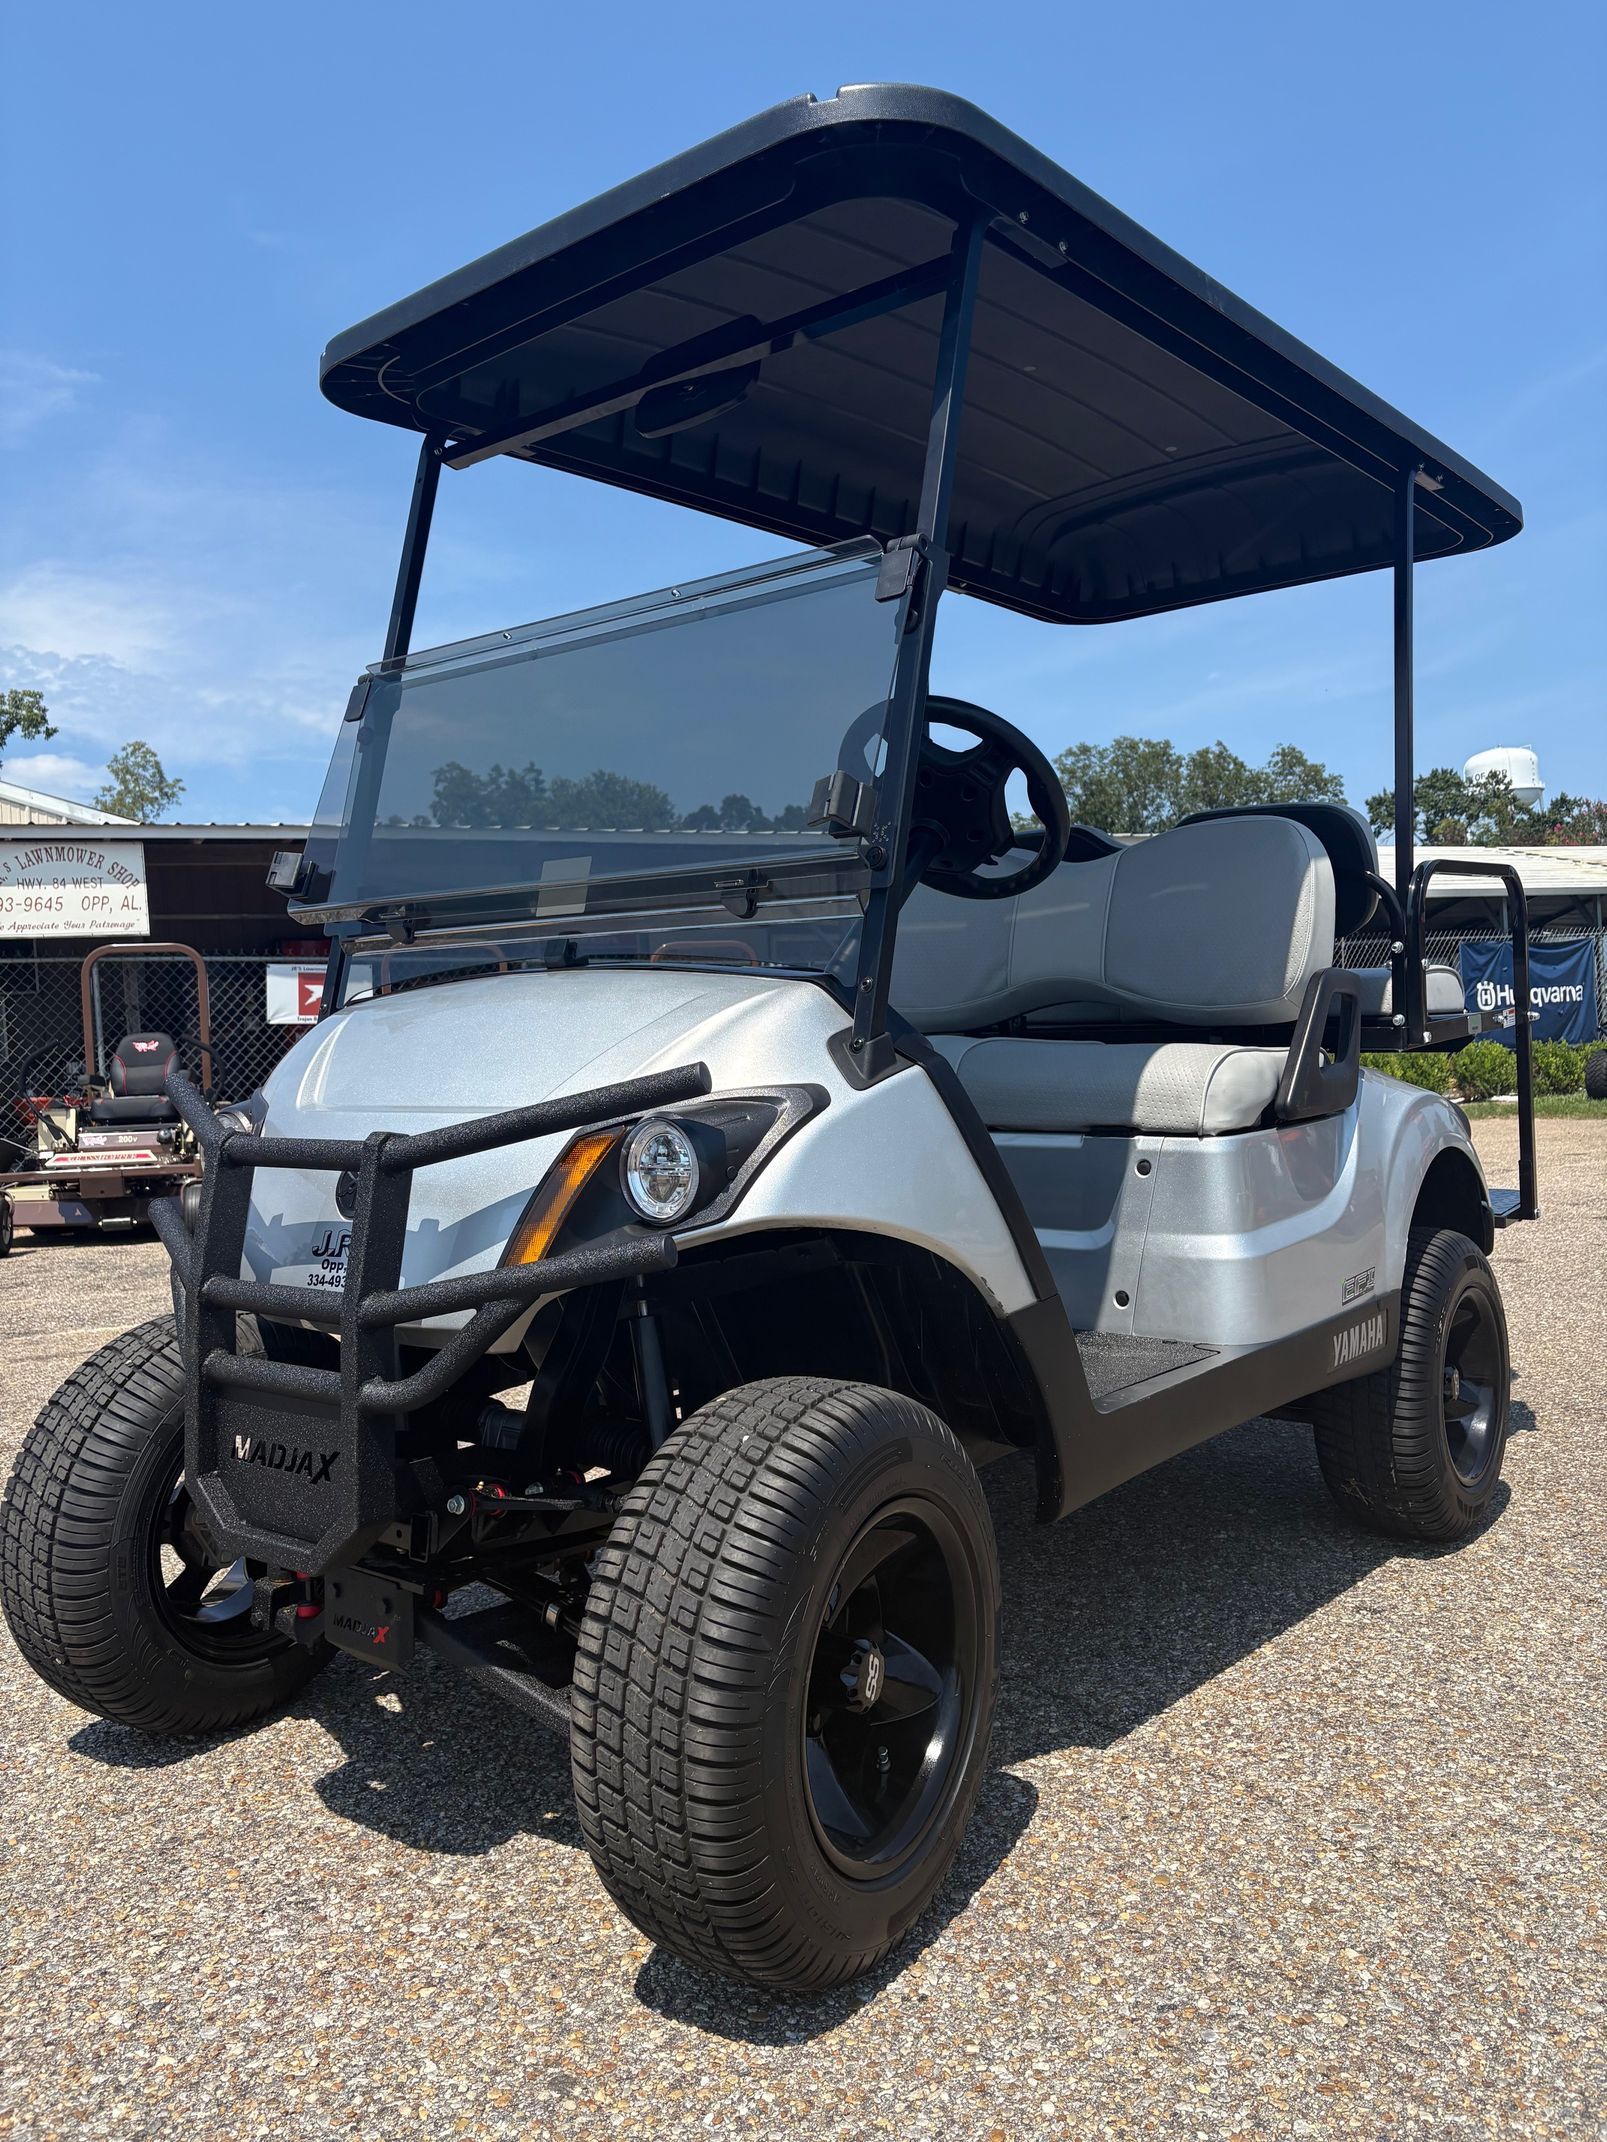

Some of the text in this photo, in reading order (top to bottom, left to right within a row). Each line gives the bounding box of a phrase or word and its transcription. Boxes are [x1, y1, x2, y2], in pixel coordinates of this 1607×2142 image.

[14, 846, 105, 870] LAWNMOWER
[107, 861, 141, 889] SHOP
[16, 877, 104, 890] HWY. 84 WEST
[81, 896, 113, 914] OPP,
[121, 896, 142, 911] AL.
[8, 921, 60, 933] Appreciate
[1342, 1267, 1376, 1305] EFI
[1332, 1314, 1383, 1368] YAMAHA
[230, 1434, 341, 1485] MADJAX
[333, 1613, 390, 1645] MADJAX
[865, 1653, 880, 1702] SS
